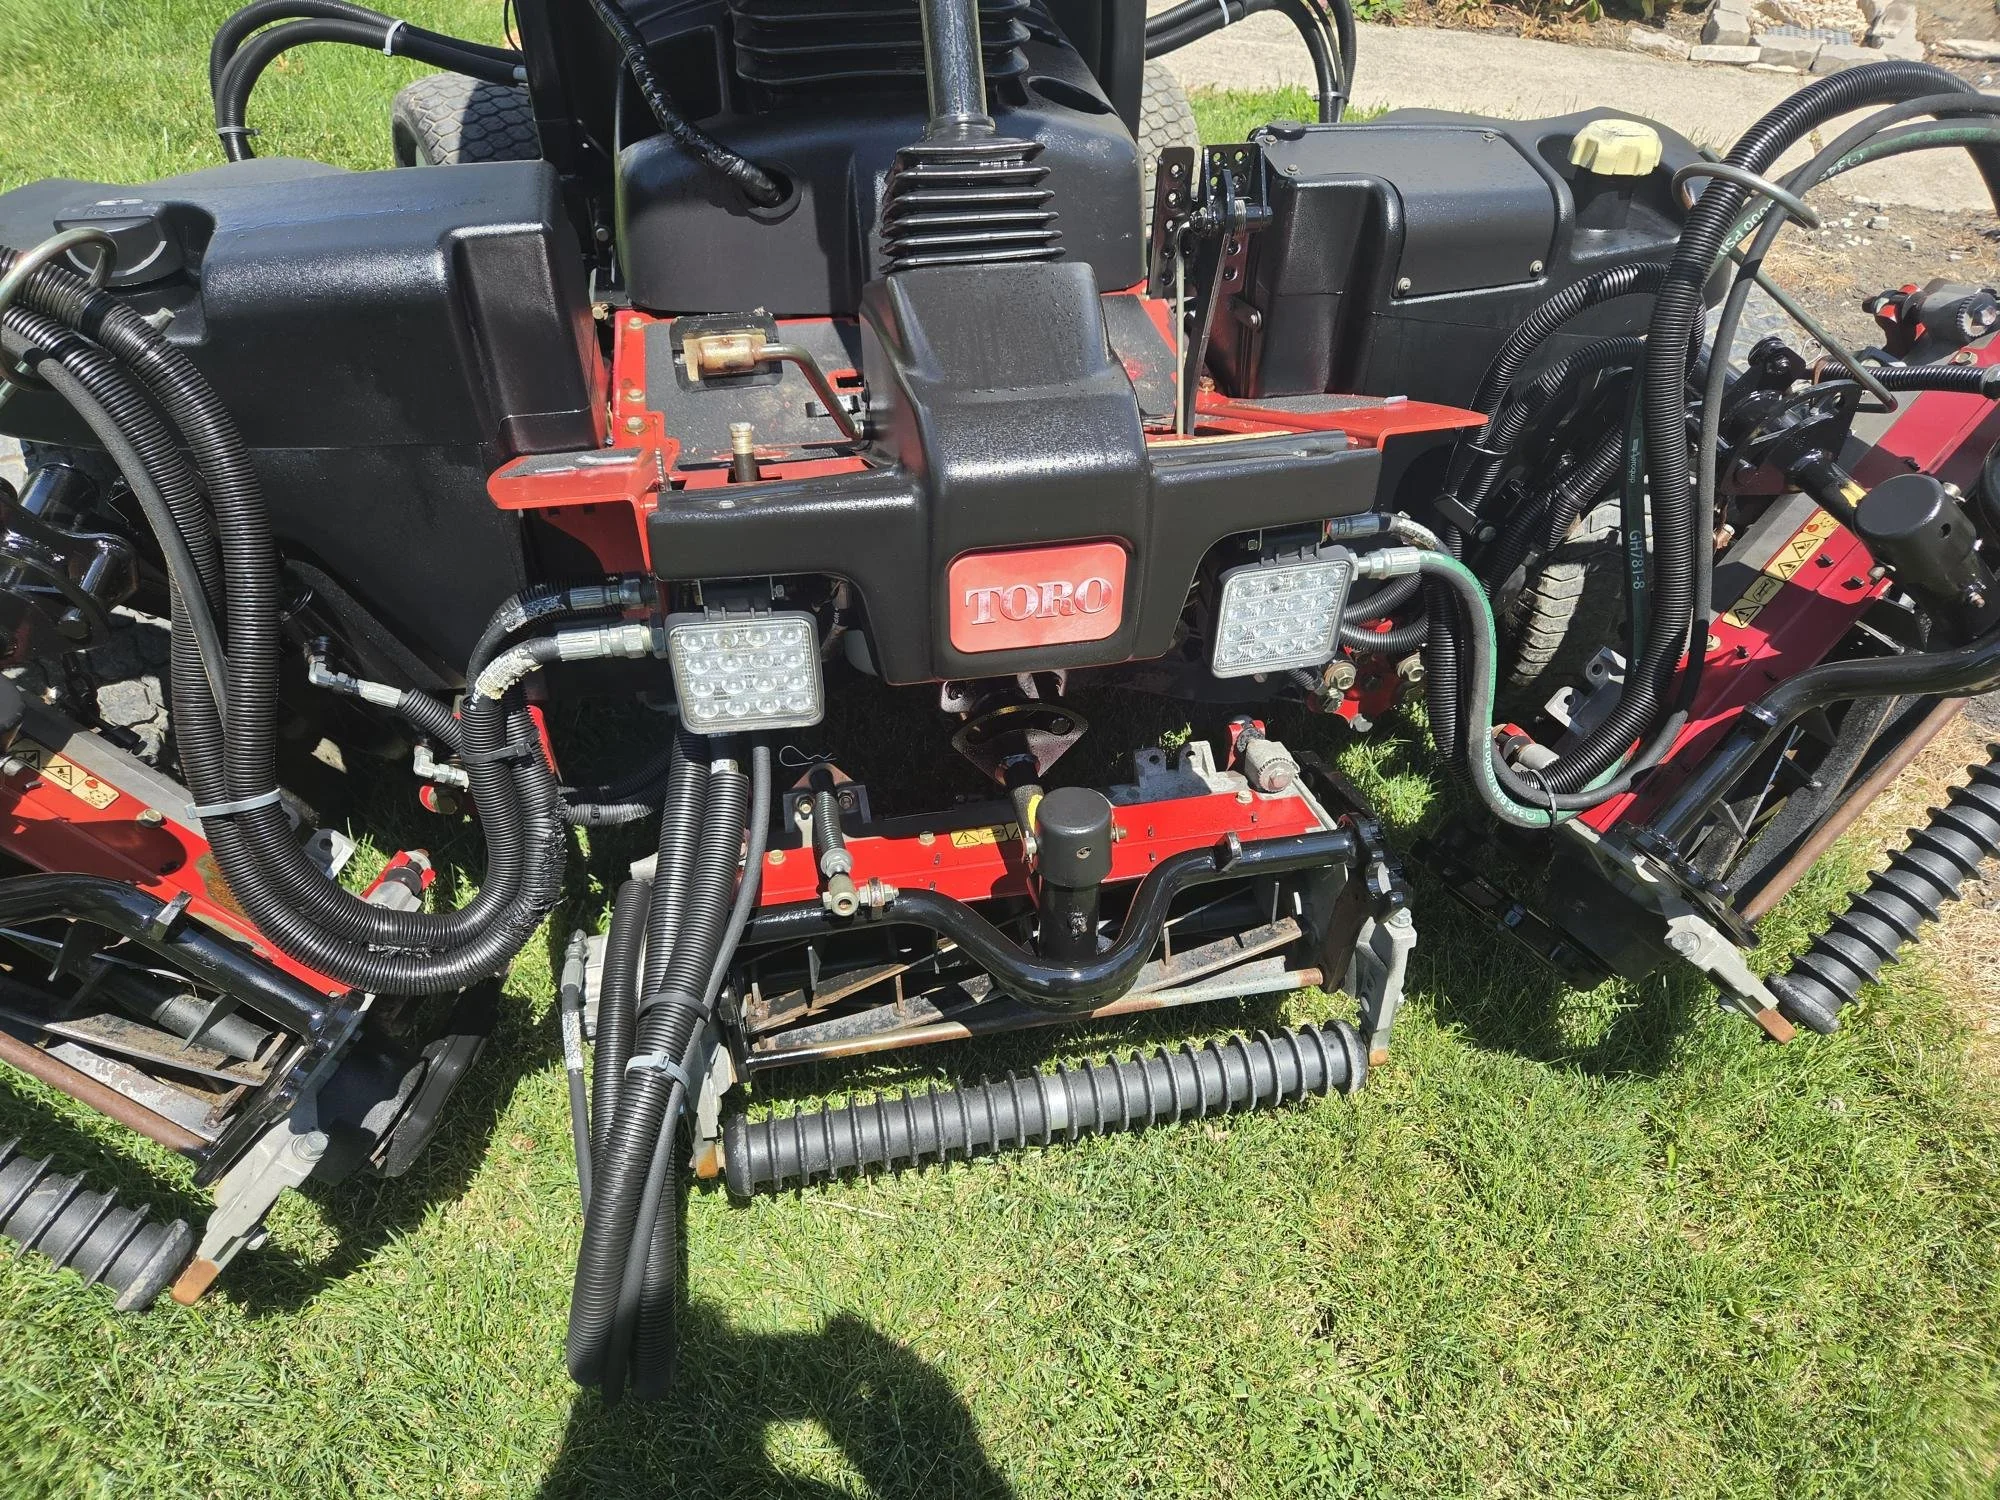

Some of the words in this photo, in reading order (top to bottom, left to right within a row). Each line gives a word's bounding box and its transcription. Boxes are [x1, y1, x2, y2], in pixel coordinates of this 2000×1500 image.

[1629, 448, 1640, 484] Aeroquip
[1629, 529, 1645, 590] GH781-8
[965, 576, 1113, 625] TORO
[1492, 785, 1509, 806] BAR
